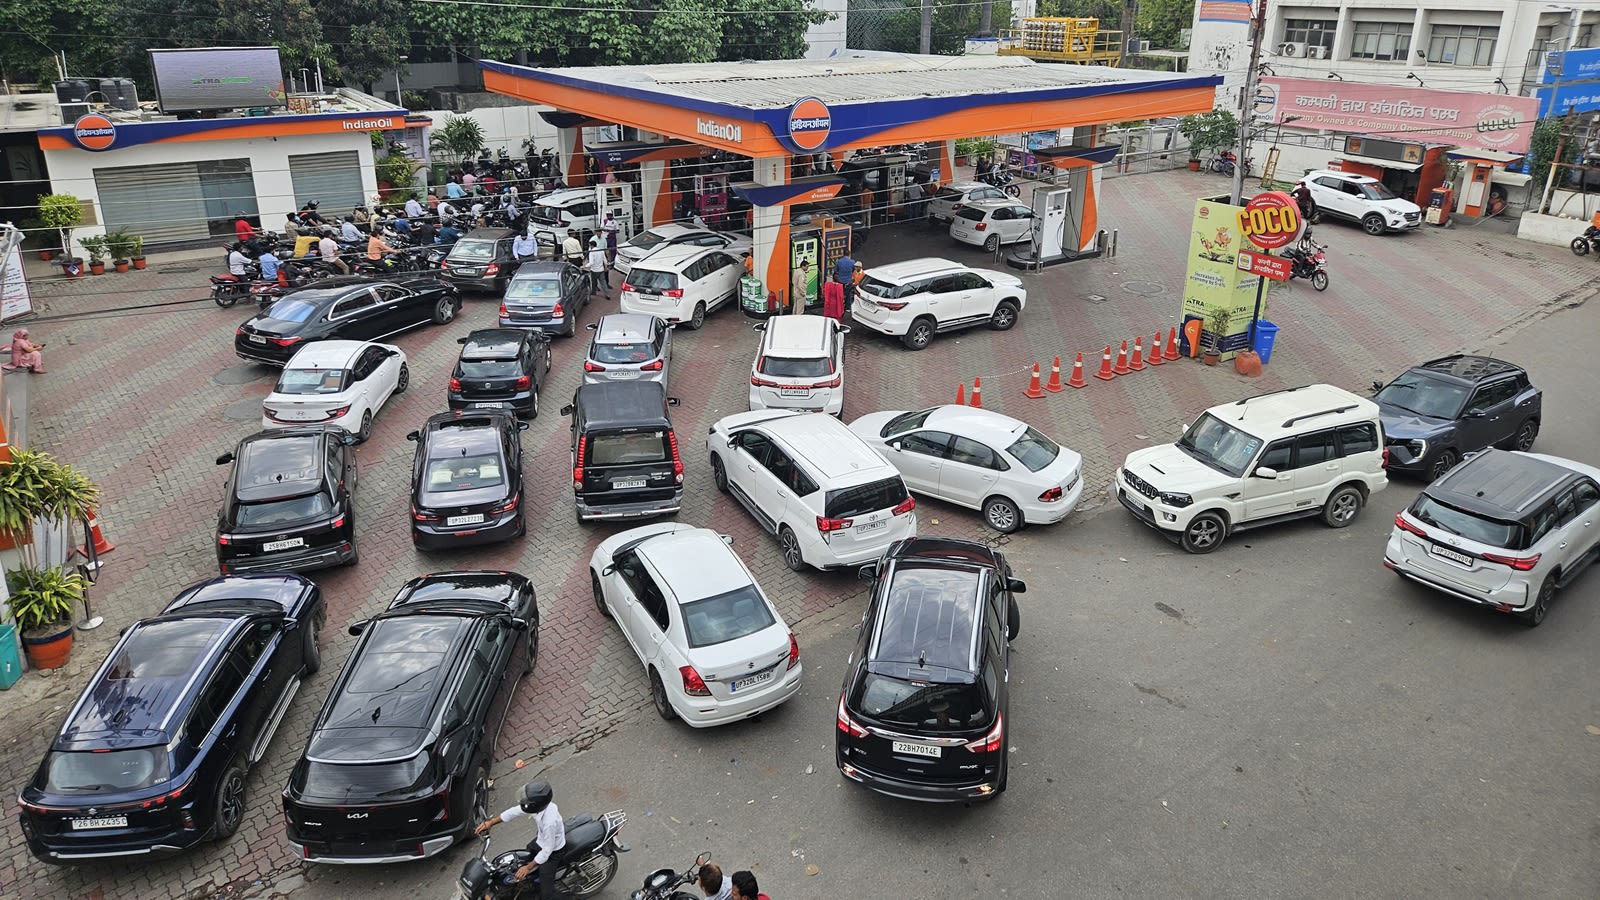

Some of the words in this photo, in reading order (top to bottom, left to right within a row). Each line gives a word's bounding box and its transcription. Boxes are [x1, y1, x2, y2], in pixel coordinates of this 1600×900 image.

[342, 118, 393, 130] IndianOil
[696, 117, 742, 143] IndianOil
[1317, 114, 1345, 126] Owned
[1347, 116, 1355, 126] &
[1356, 118, 1398, 131] Company
[1445, 129, 1473, 140] Pump
[1235, 206, 1298, 236] COCO
[898, 743, 938, 755] 22BH7014E
[78, 820, 88, 828] 26
[90, 819, 100, 827] BH
[101, 818, 121, 826] 2435
